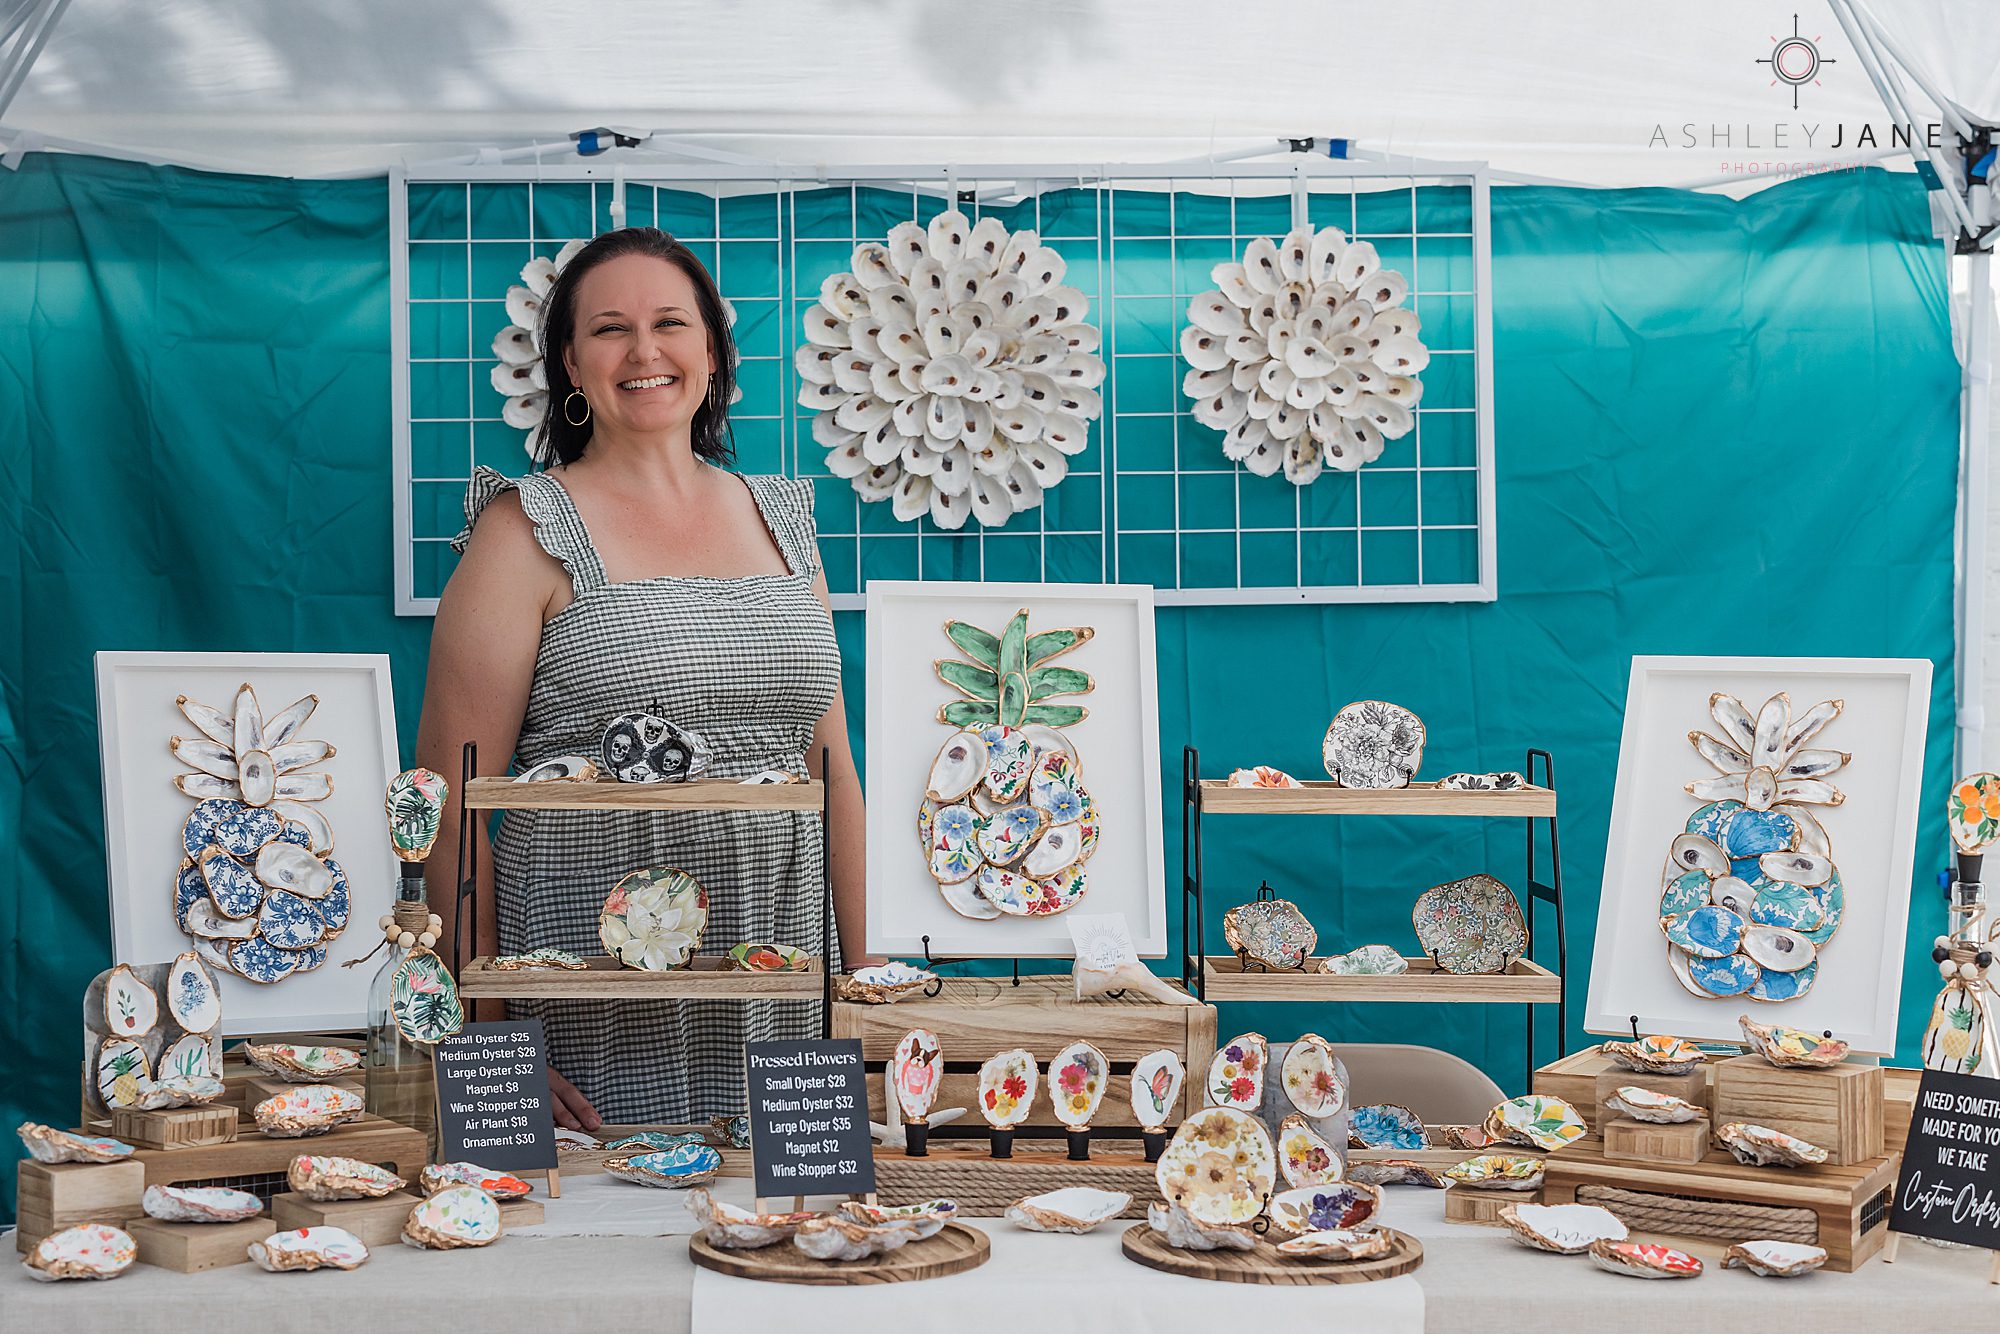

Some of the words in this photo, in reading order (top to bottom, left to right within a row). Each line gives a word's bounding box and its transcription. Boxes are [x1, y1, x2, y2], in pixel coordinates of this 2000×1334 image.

[445, 1035, 473, 1045] Small
[475, 1034, 508, 1045] Oyster
[511, 1032, 530, 1043] $25
[440, 1050, 480, 1062] Medium
[482, 1048, 515, 1061] Oyster
[518, 1046, 536, 1058] $28
[750, 1051, 802, 1068] Pressed
[805, 1051, 857, 1066] Flowers
[447, 1068, 477, 1080] Large
[479, 1066, 512, 1079] Oyster
[514, 1063, 533, 1075] $32
[466, 1084, 504, 1097] Magnet
[506, 1081, 519, 1094] $8
[766, 1076, 793, 1091] Small
[794, 1076, 826, 1092] Oyster
[827, 1074, 846, 1089] $28
[450, 1102, 474, 1114] Wine
[477, 1101, 518, 1113] Stopper
[520, 1097, 540, 1109] $28
[762, 1099, 800, 1112] Medium
[802, 1097, 833, 1113] Oyster
[835, 1095, 854, 1109] $32
[1923, 1090, 1954, 1111] NEED
[465, 1119, 479, 1130] Air
[482, 1117, 508, 1129] Plant
[511, 1116, 528, 1128] $18
[769, 1120, 797, 1136] Large
[800, 1119, 830, 1135] Oyster
[832, 1117, 851, 1132] $35
[1921, 1117, 1957, 1139] MADE
[1958, 1123, 1982, 1143] FOR
[1984, 1126, 2000, 1146] YO
[463, 1135, 513, 1149] Ornament
[515, 1133, 535, 1145] $30
[786, 1141, 821, 1157] Magnet
[823, 1139, 839, 1153] $12
[1937, 1146, 1957, 1166] WE
[1958, 1149, 1989, 1172] TAKE
[771, 1163, 796, 1177] Wine
[798, 1162, 836, 1178] Stopper
[838, 1160, 857, 1175] $32
[1903, 1170, 1955, 1219] Custom
[1952, 1183, 2000, 1228] Orders
